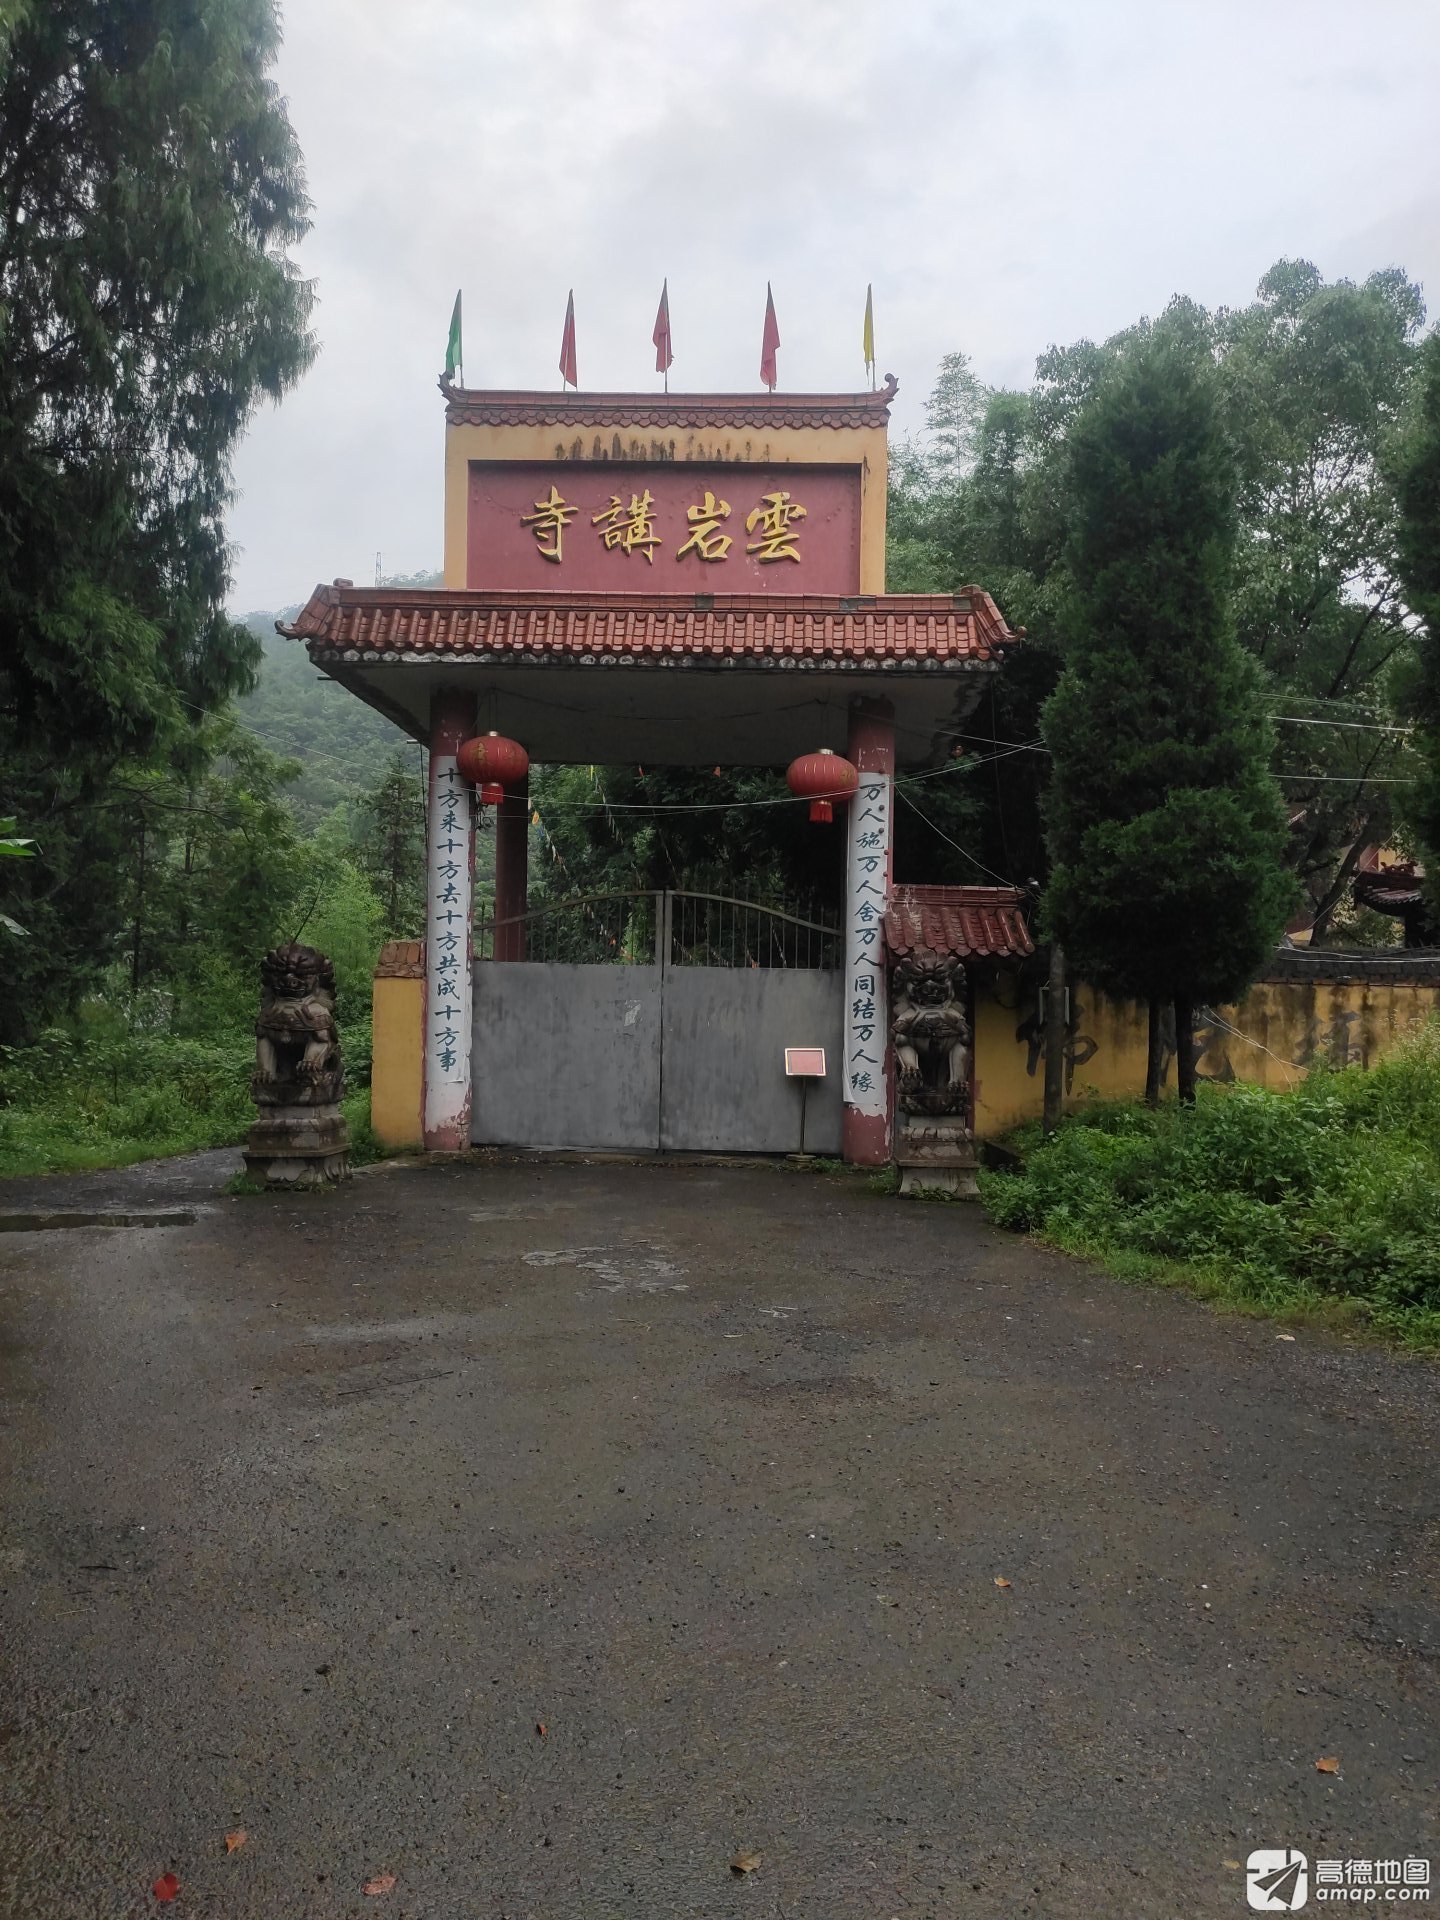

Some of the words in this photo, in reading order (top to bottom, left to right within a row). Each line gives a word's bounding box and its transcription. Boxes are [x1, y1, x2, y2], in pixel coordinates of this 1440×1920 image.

[520, 485, 808, 565] 雲岩講寺
[434, 767, 465, 1073] 十方来十方去十方共成十方事
[850, 782, 886, 1093] 万人施万人舍万人同结万人缘
